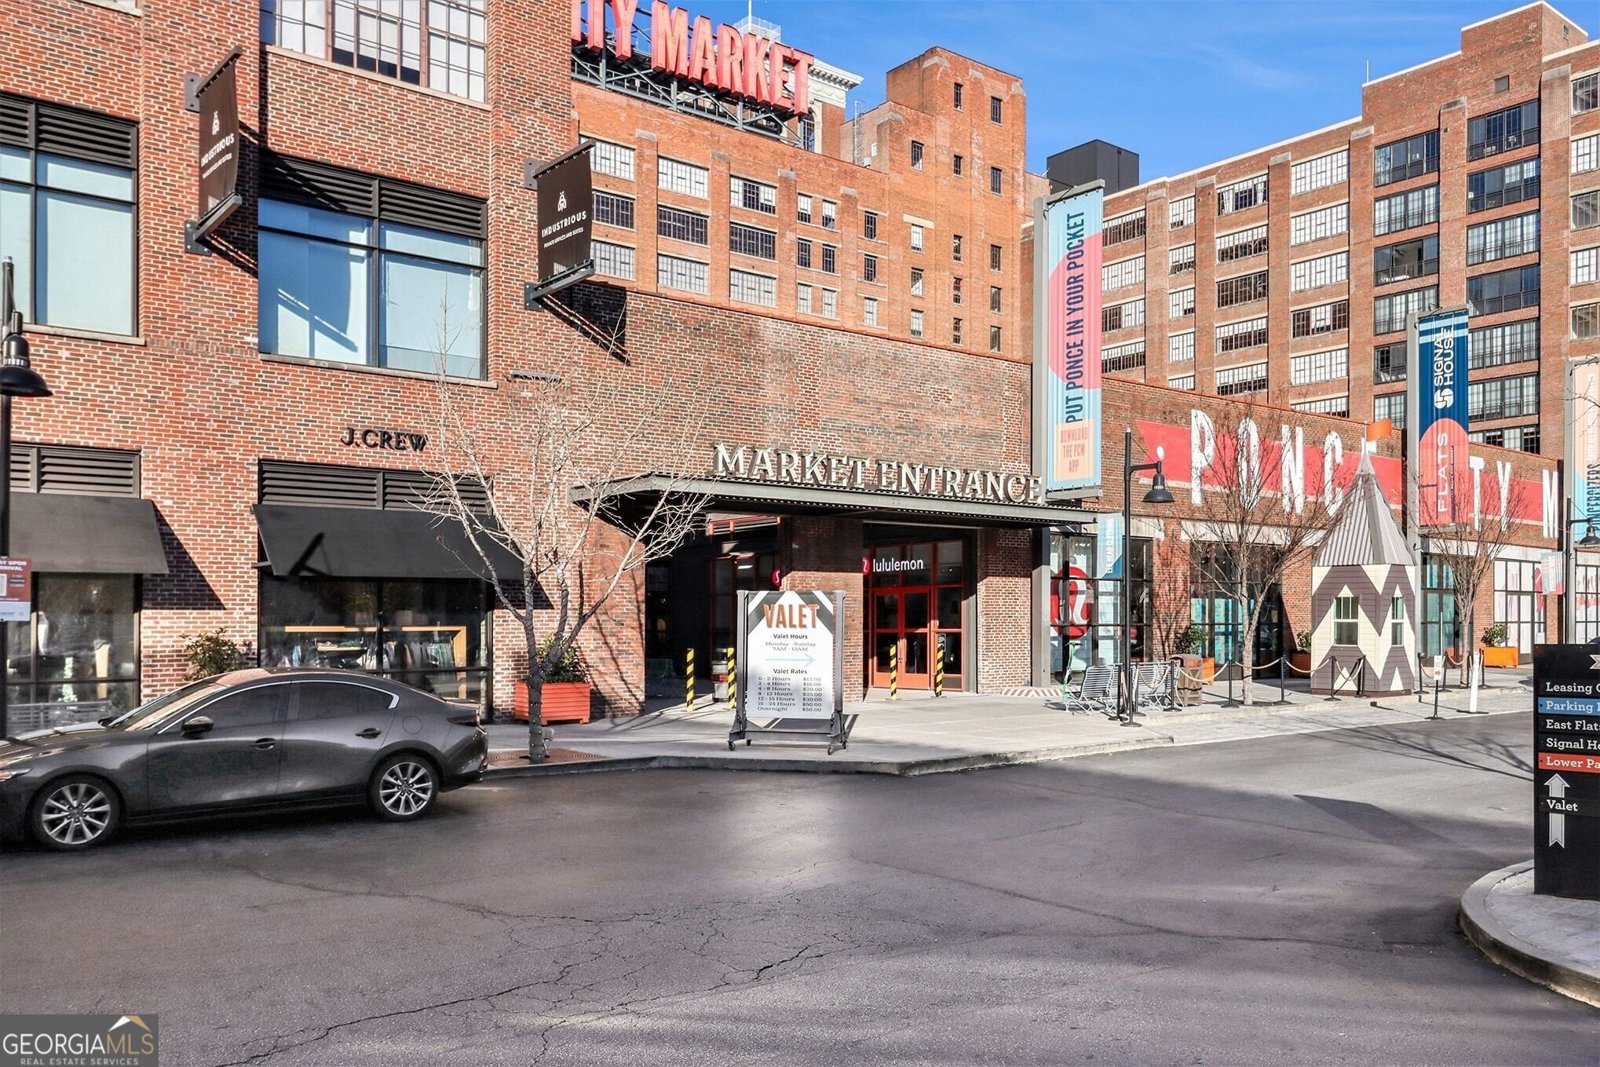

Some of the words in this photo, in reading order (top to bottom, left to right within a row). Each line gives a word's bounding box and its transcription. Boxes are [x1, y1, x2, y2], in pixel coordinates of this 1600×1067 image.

[652, 0, 814, 116] MARKET
[201, 133, 234, 167] INDUSTRIOUS
[541, 211, 587, 238] INDUSTRIOUS
[1066, 212, 1085, 271] POCKET
[1066, 273, 1084, 316] YOUR
[1066, 319, 1084, 336] IN
[1066, 339, 1084, 391] PONCE
[1434, 328, 1443, 386] SIGNAL
[1443, 328, 1454, 386] HOUSE
[1065, 395, 1083, 423] PUT
[340, 427, 428, 451] J.CREW
[1063, 444, 1073, 458] THE
[713, 443, 869, 488] MARKET
[877, 459, 1043, 504] ENTRANCE
[1068, 459, 1079, 472] APP
[1437, 432, 1448, 512] FLATS
[872, 557, 924, 573] lululemon
[763, 603, 820, 629] VALET
[1546, 682, 1593, 695] Leasing
[1546, 700, 1594, 714] Parking
[1546, 719, 1572, 730] East
[1575, 720, 1600, 731] Flat
[1546, 738, 1584, 750] Signal
[1546, 756, 1583, 768] Lower
[1546, 799, 1578, 812] Valet
